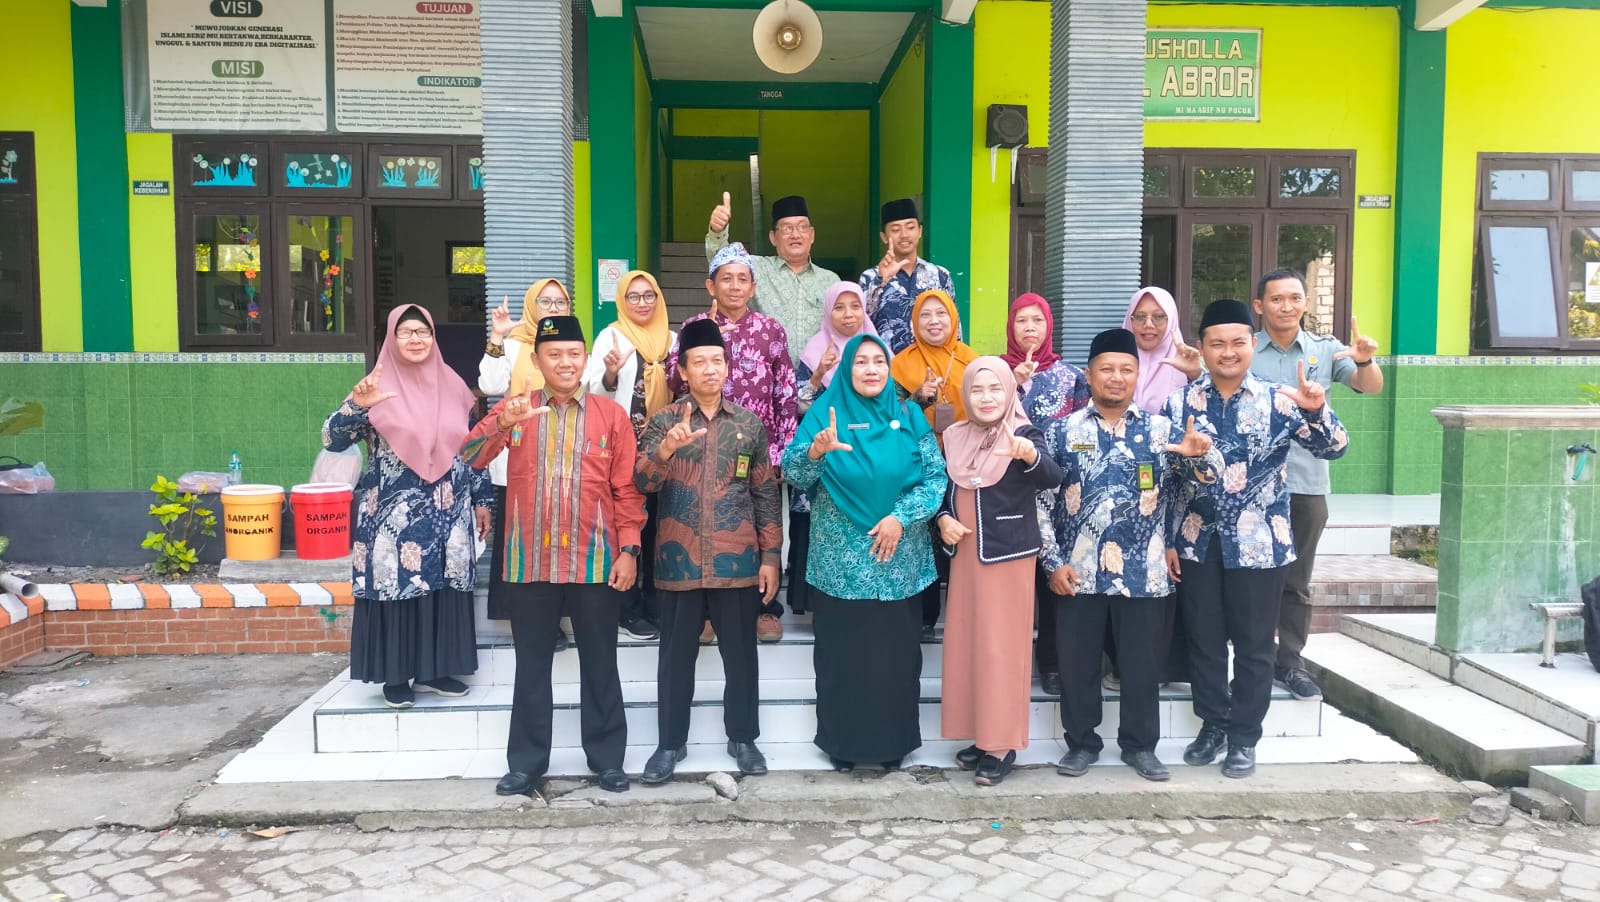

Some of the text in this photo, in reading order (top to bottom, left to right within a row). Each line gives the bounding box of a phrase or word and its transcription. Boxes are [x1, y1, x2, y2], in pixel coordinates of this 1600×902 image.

[220, 1, 252, 15] VISI
[422, 3, 467, 13] TUJUAN
[248, 25, 283, 33] GENERASI
[1144, 37, 1244, 60] USHOLLA
[220, 61, 256, 75] MISI
[424, 76, 476, 86] INDIKATOR
[1160, 65, 1254, 98] ABROR
[1175, 106, 1184, 114] MI
[227, 513, 269, 523] SAMPAH
[306, 511, 347, 522] SAMPAH
